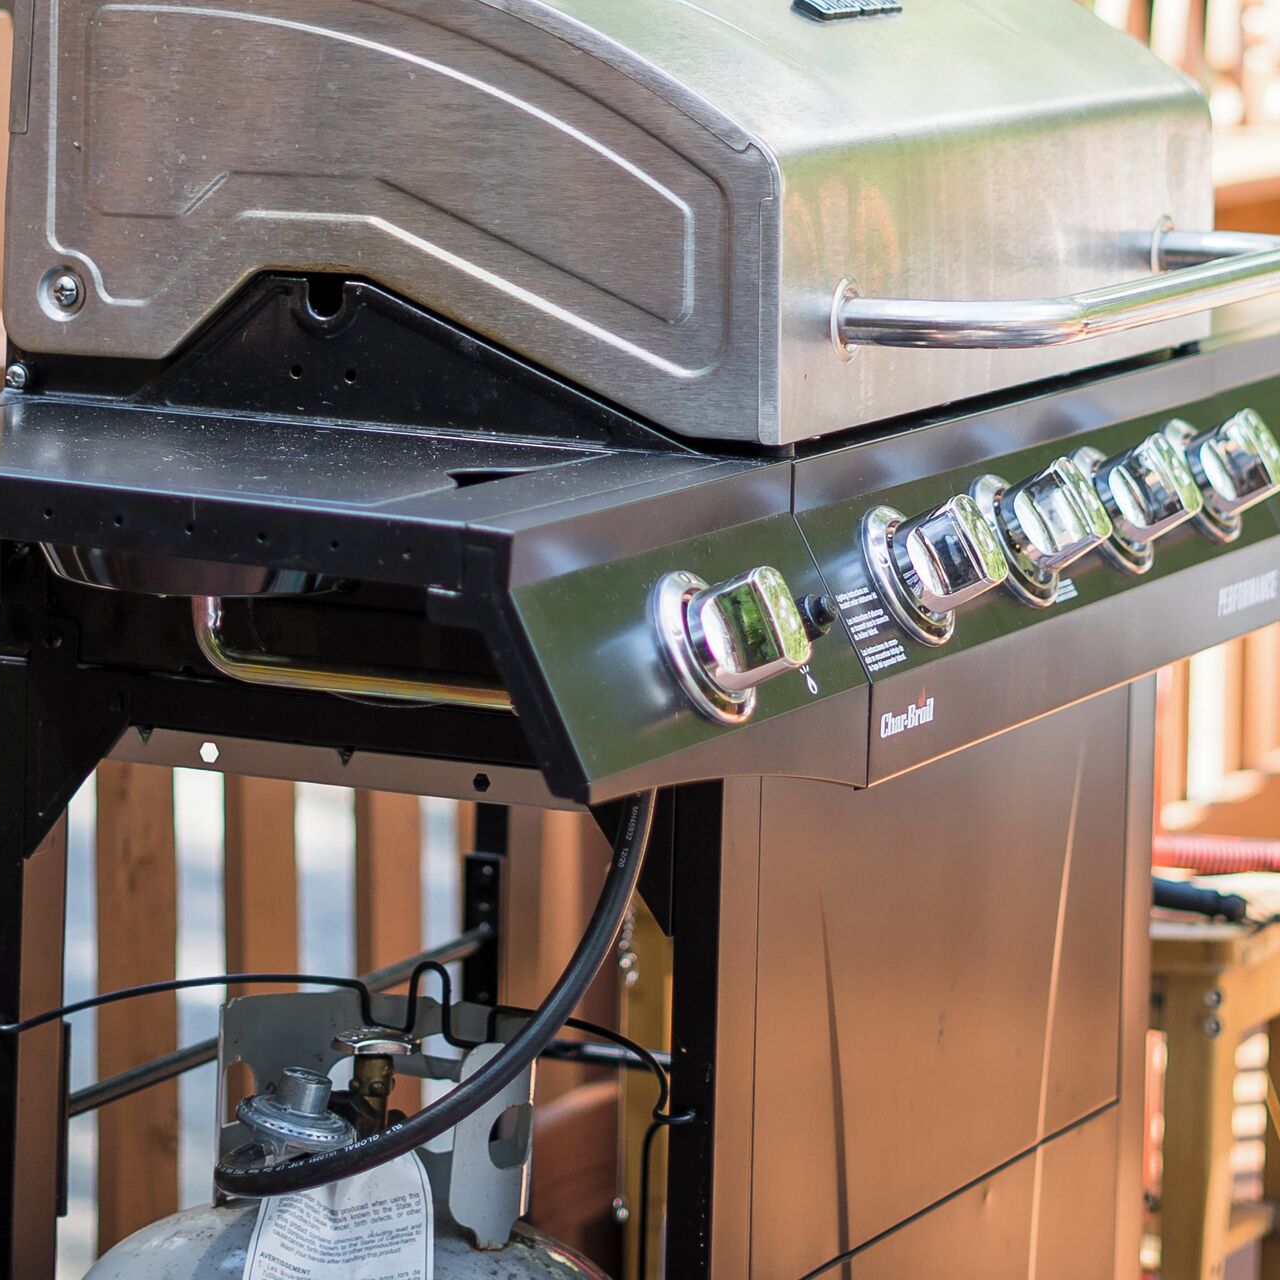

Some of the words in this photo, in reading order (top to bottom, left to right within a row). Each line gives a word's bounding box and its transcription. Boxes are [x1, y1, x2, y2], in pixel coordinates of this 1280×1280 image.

[1217, 569, 1280, 618] PERFORMANCE
[617, 847, 629, 868] 12/20
[343, 1133, 380, 1152] GLOBAL
[259, 1251, 311, 1276] AVERTISSEMENT
